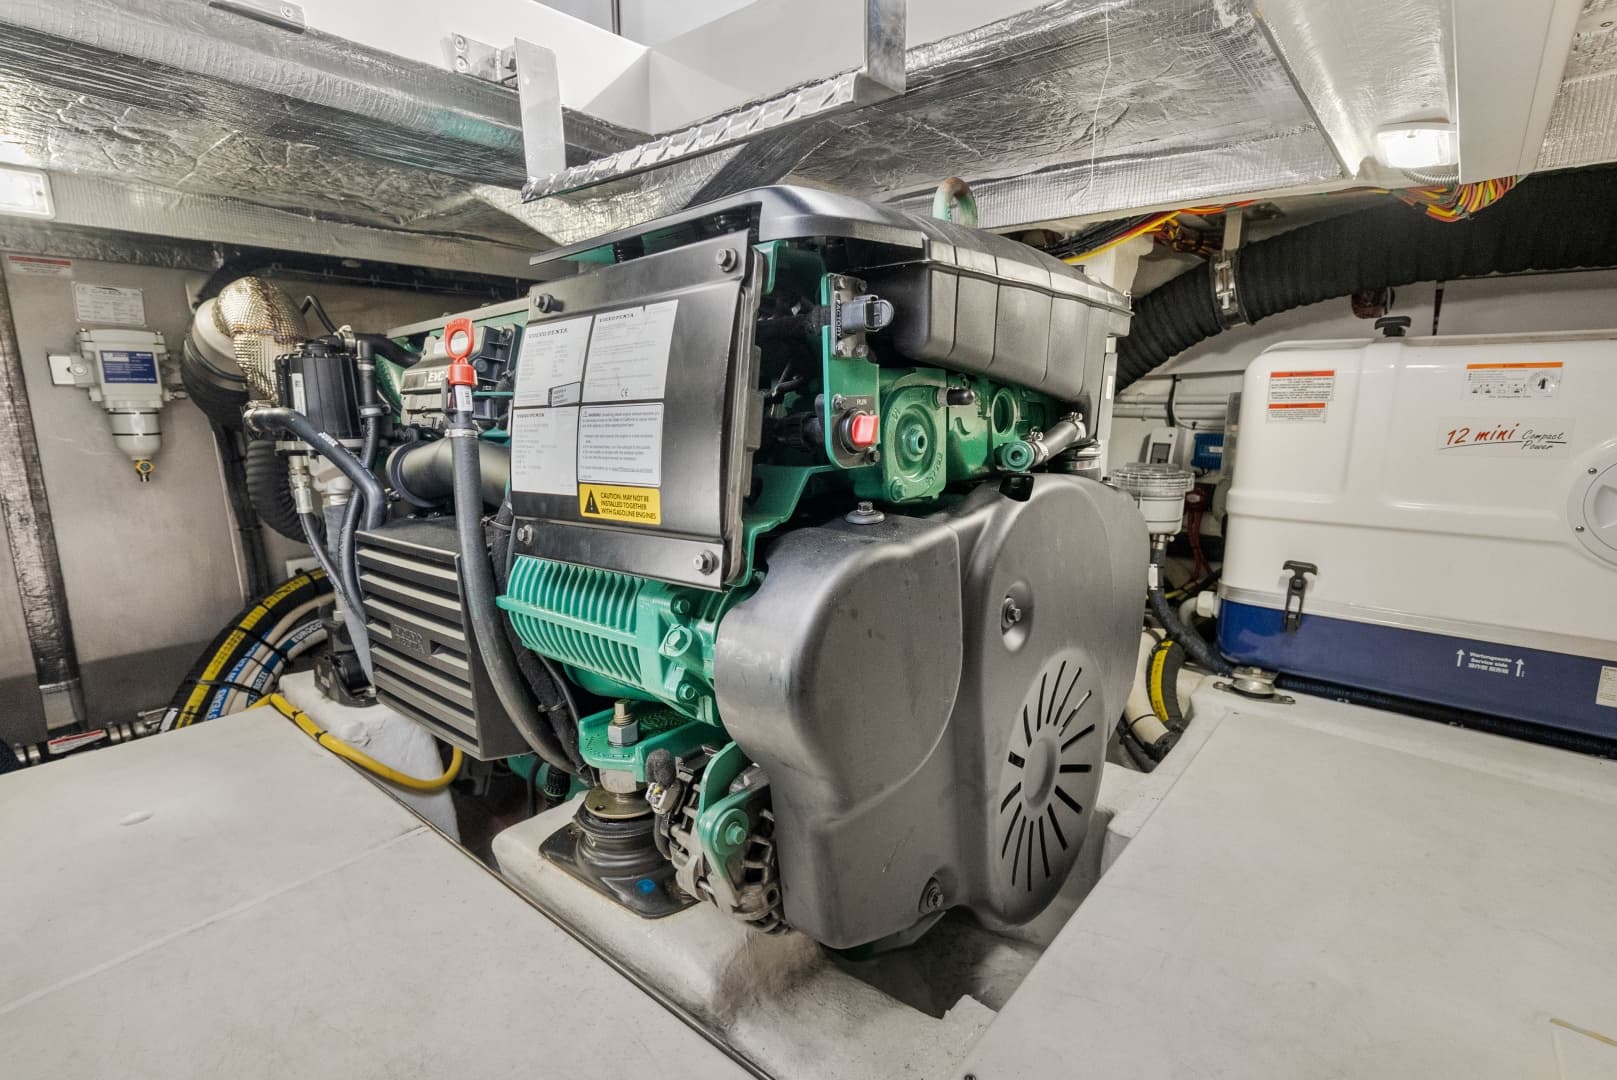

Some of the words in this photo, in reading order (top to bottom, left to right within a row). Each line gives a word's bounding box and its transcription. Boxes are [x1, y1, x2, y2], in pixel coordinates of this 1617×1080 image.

[1447, 427, 1470, 445] 12
[1474, 423, 1520, 442] mini
[1521, 429, 1564, 441] Compact
[1521, 440, 1553, 450] Power
[622, 493, 633, 501] MAY
[633, 494, 643, 502] NOT
[601, 500, 623, 508] INSTALLED
[623, 502, 647, 510] TOGETHER
[612, 508, 636, 518] GASOLINE
[635, 511, 657, 520] ENGINES
